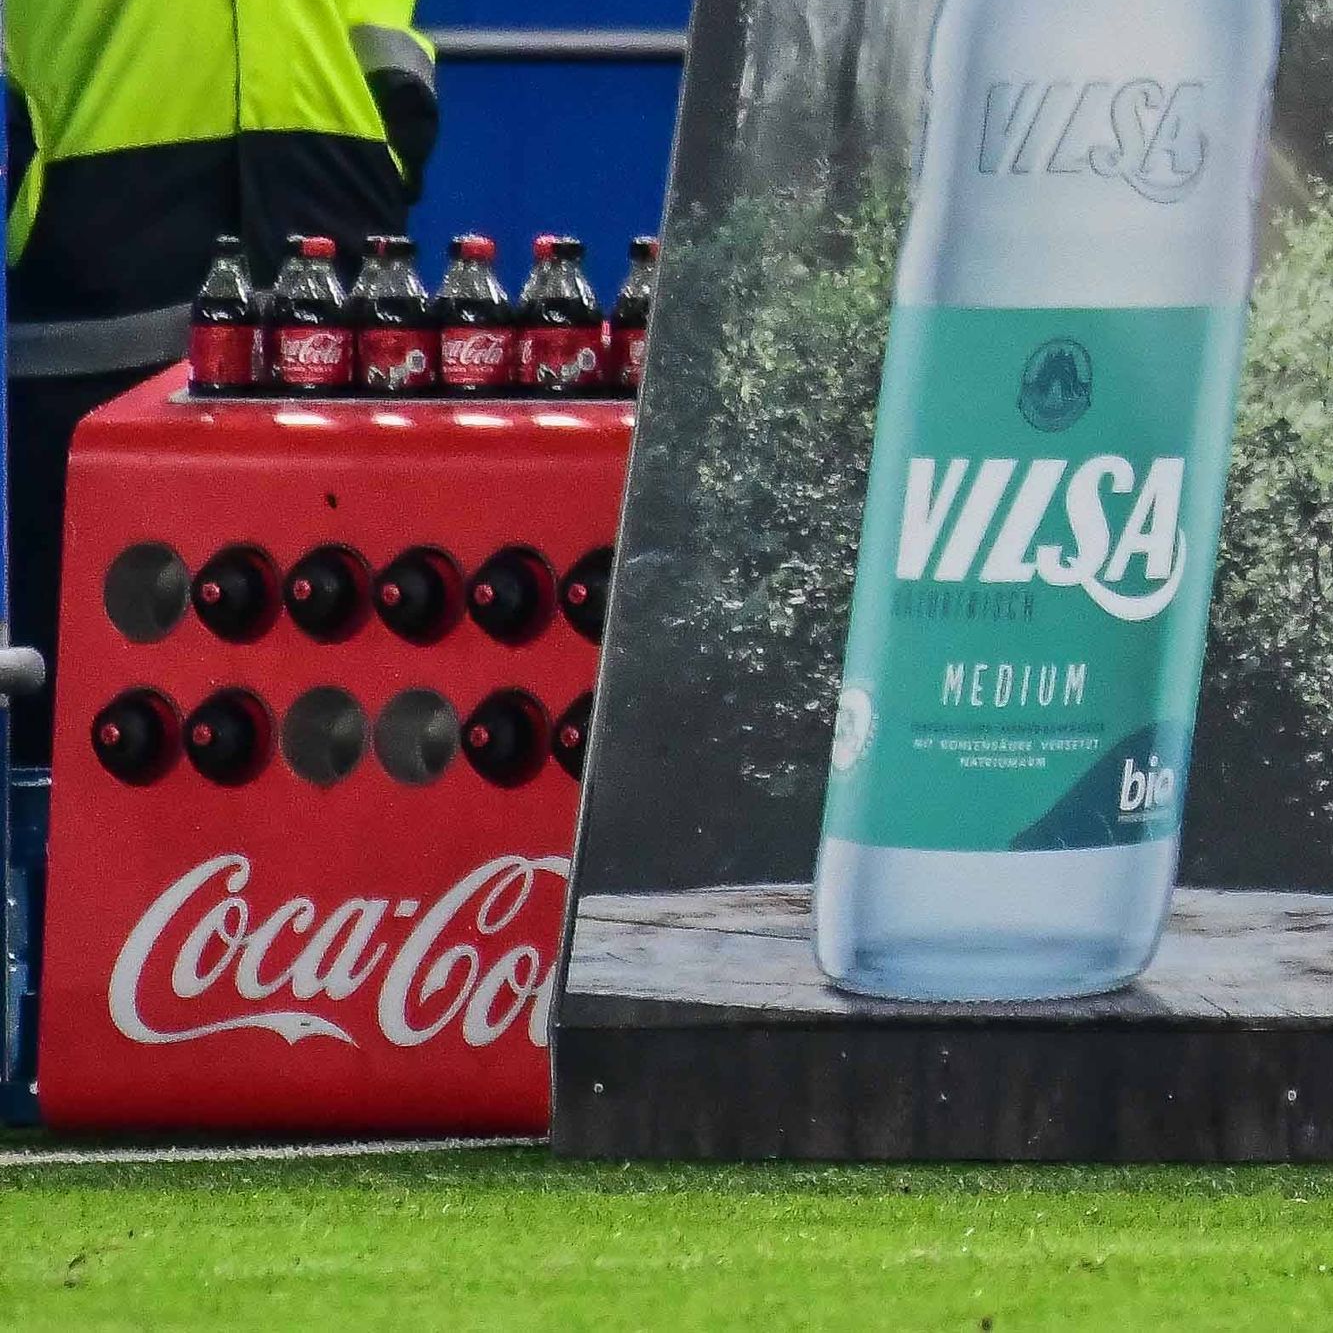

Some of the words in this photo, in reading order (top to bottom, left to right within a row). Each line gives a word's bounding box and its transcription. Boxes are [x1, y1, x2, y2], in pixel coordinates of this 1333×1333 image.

[895, 454, 1187, 621] VILSA
[942, 662, 1088, 707] MEDIUM
[1120, 755, 1176, 811] bio
